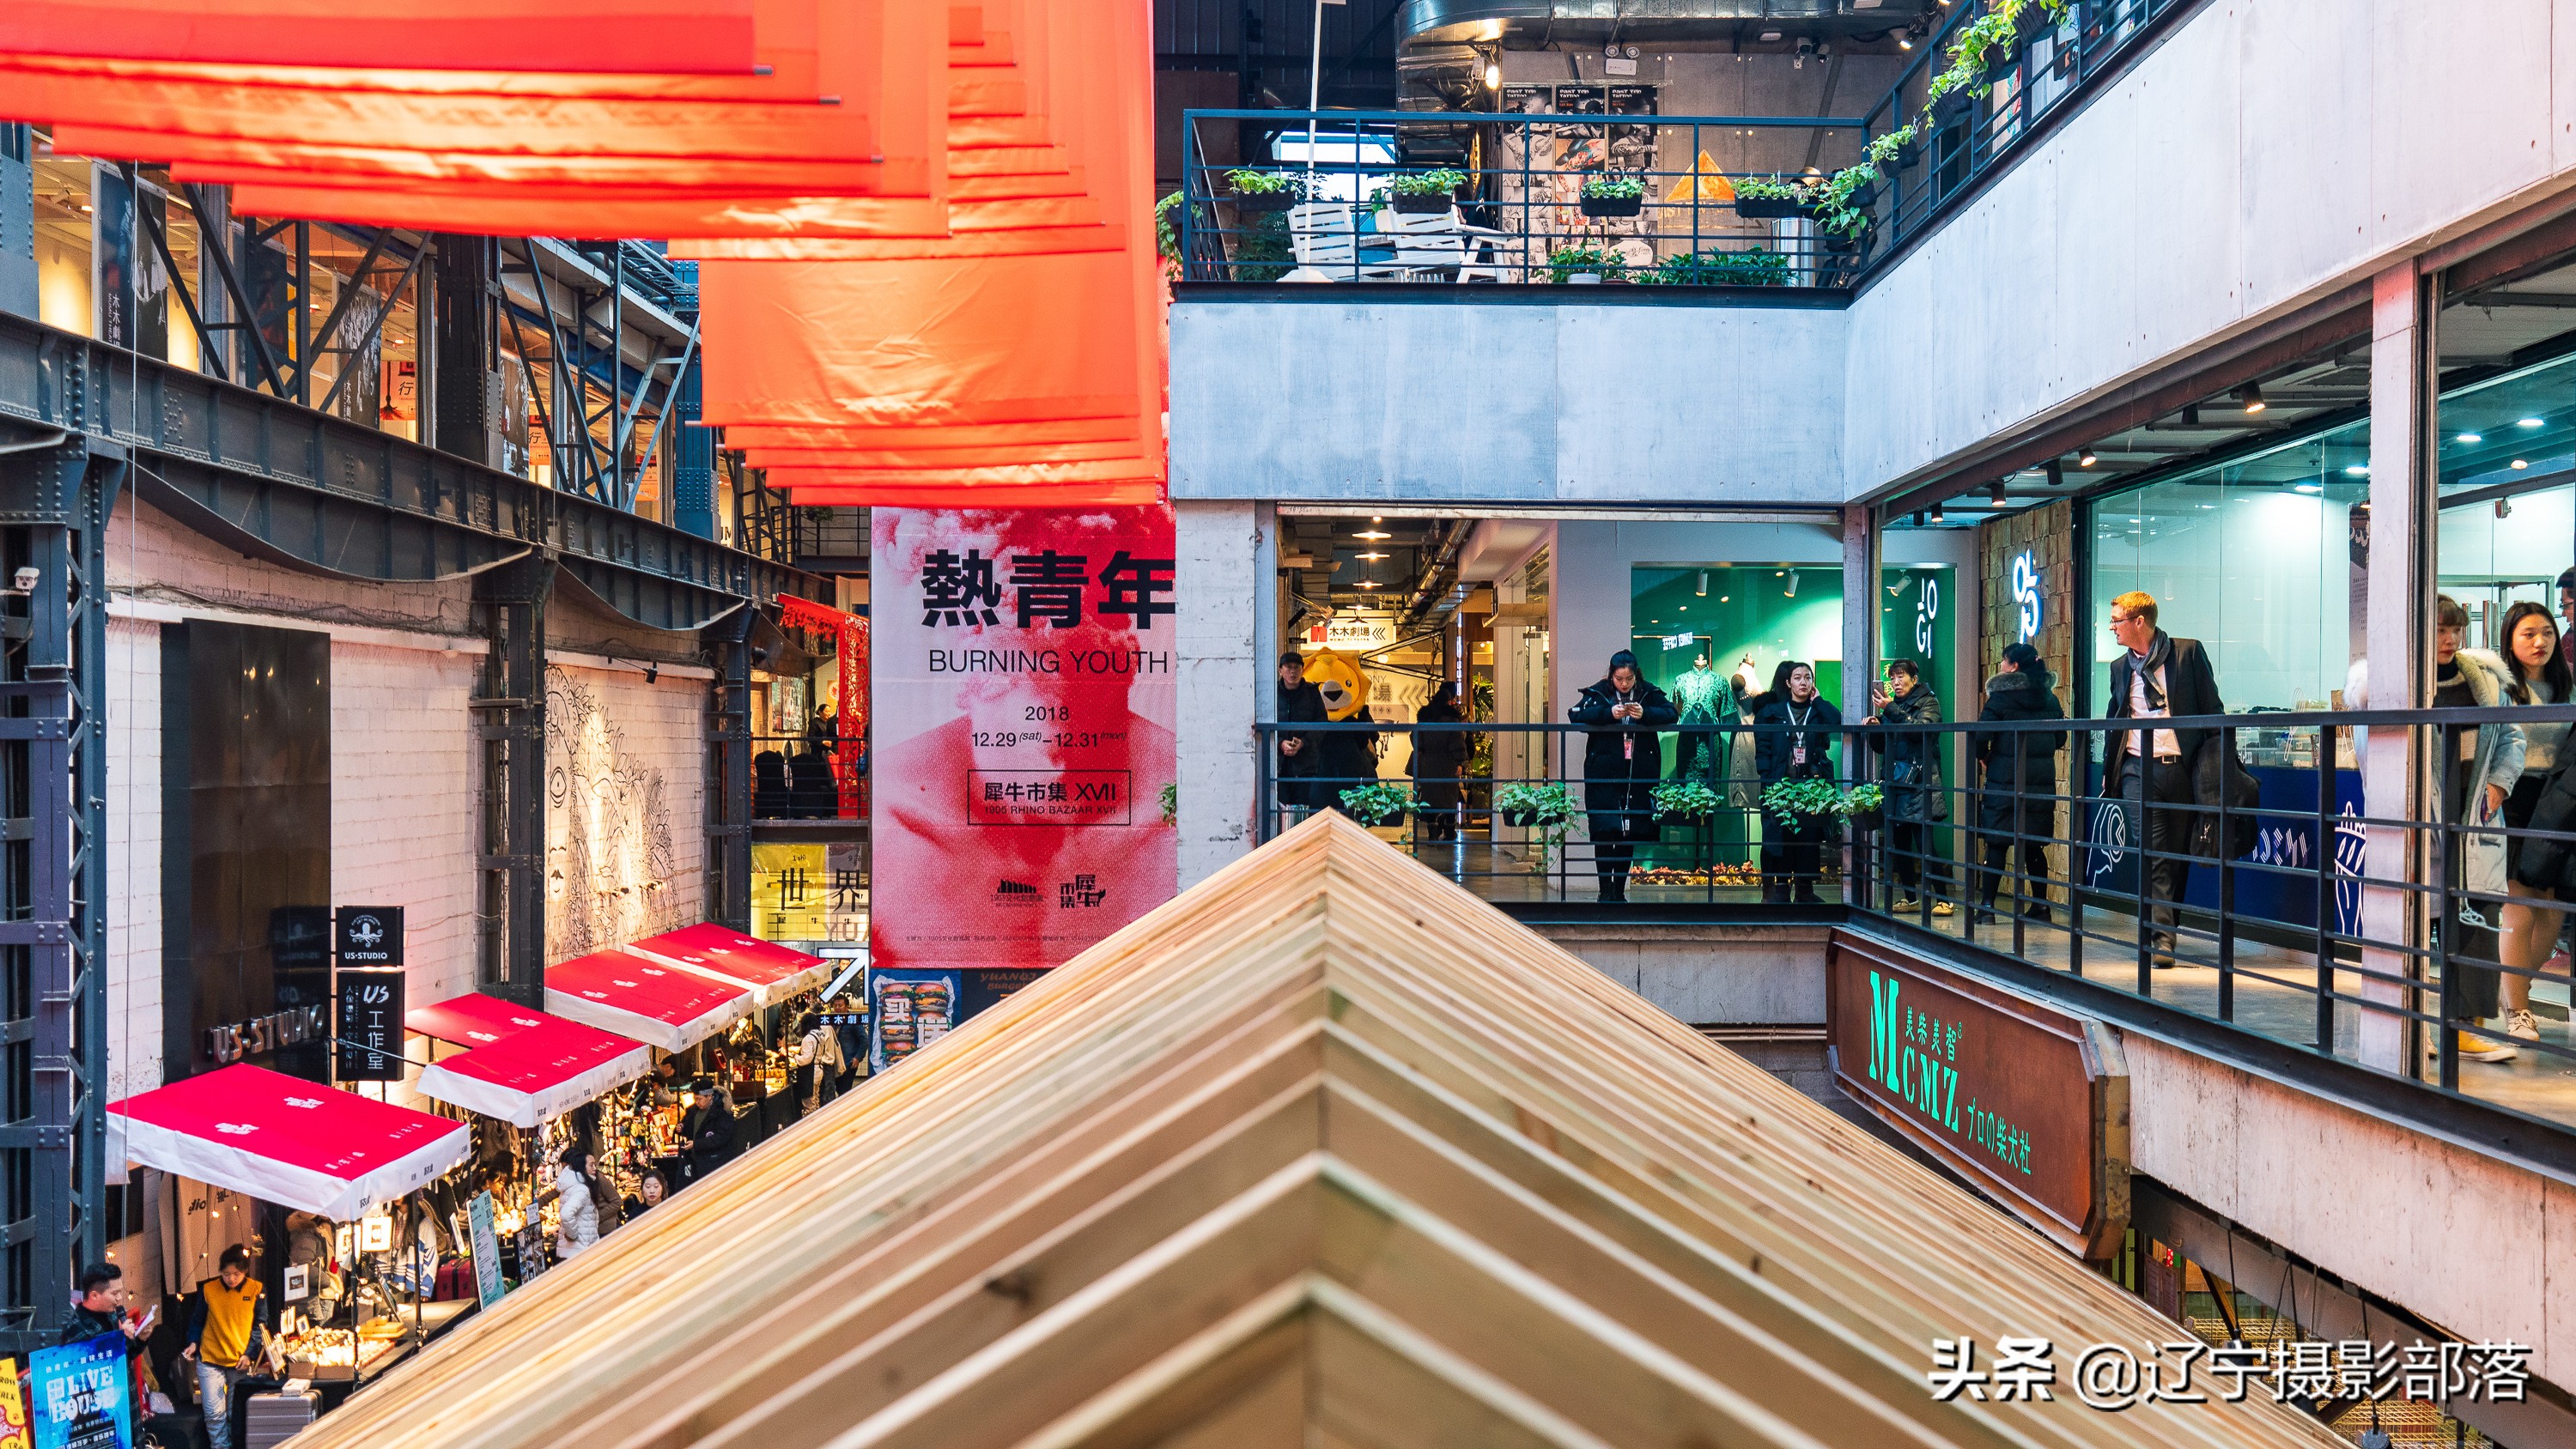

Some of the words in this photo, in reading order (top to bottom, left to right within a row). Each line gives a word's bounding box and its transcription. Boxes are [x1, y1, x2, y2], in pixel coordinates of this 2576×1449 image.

[398, 381, 415, 395] 行
[920, 549, 1176, 629] 熱青年
[1329, 627, 1370, 636] 木木劇場
[929, 650, 1060, 673] BURNING
[1070, 651, 1168, 674] YOUTH
[1024, 706, 1070, 721] 2018
[984, 782, 1067, 802] 犀牛市集
[985, 805, 1007, 815] 1905
[1011, 805, 1045, 815] RHINO
[1048, 805, 1093, 815] BAZAAR
[363, 985, 389, 1003] US
[368, 1011, 384, 1070] 工作室
[67, 1365, 113, 1396] LIVE
